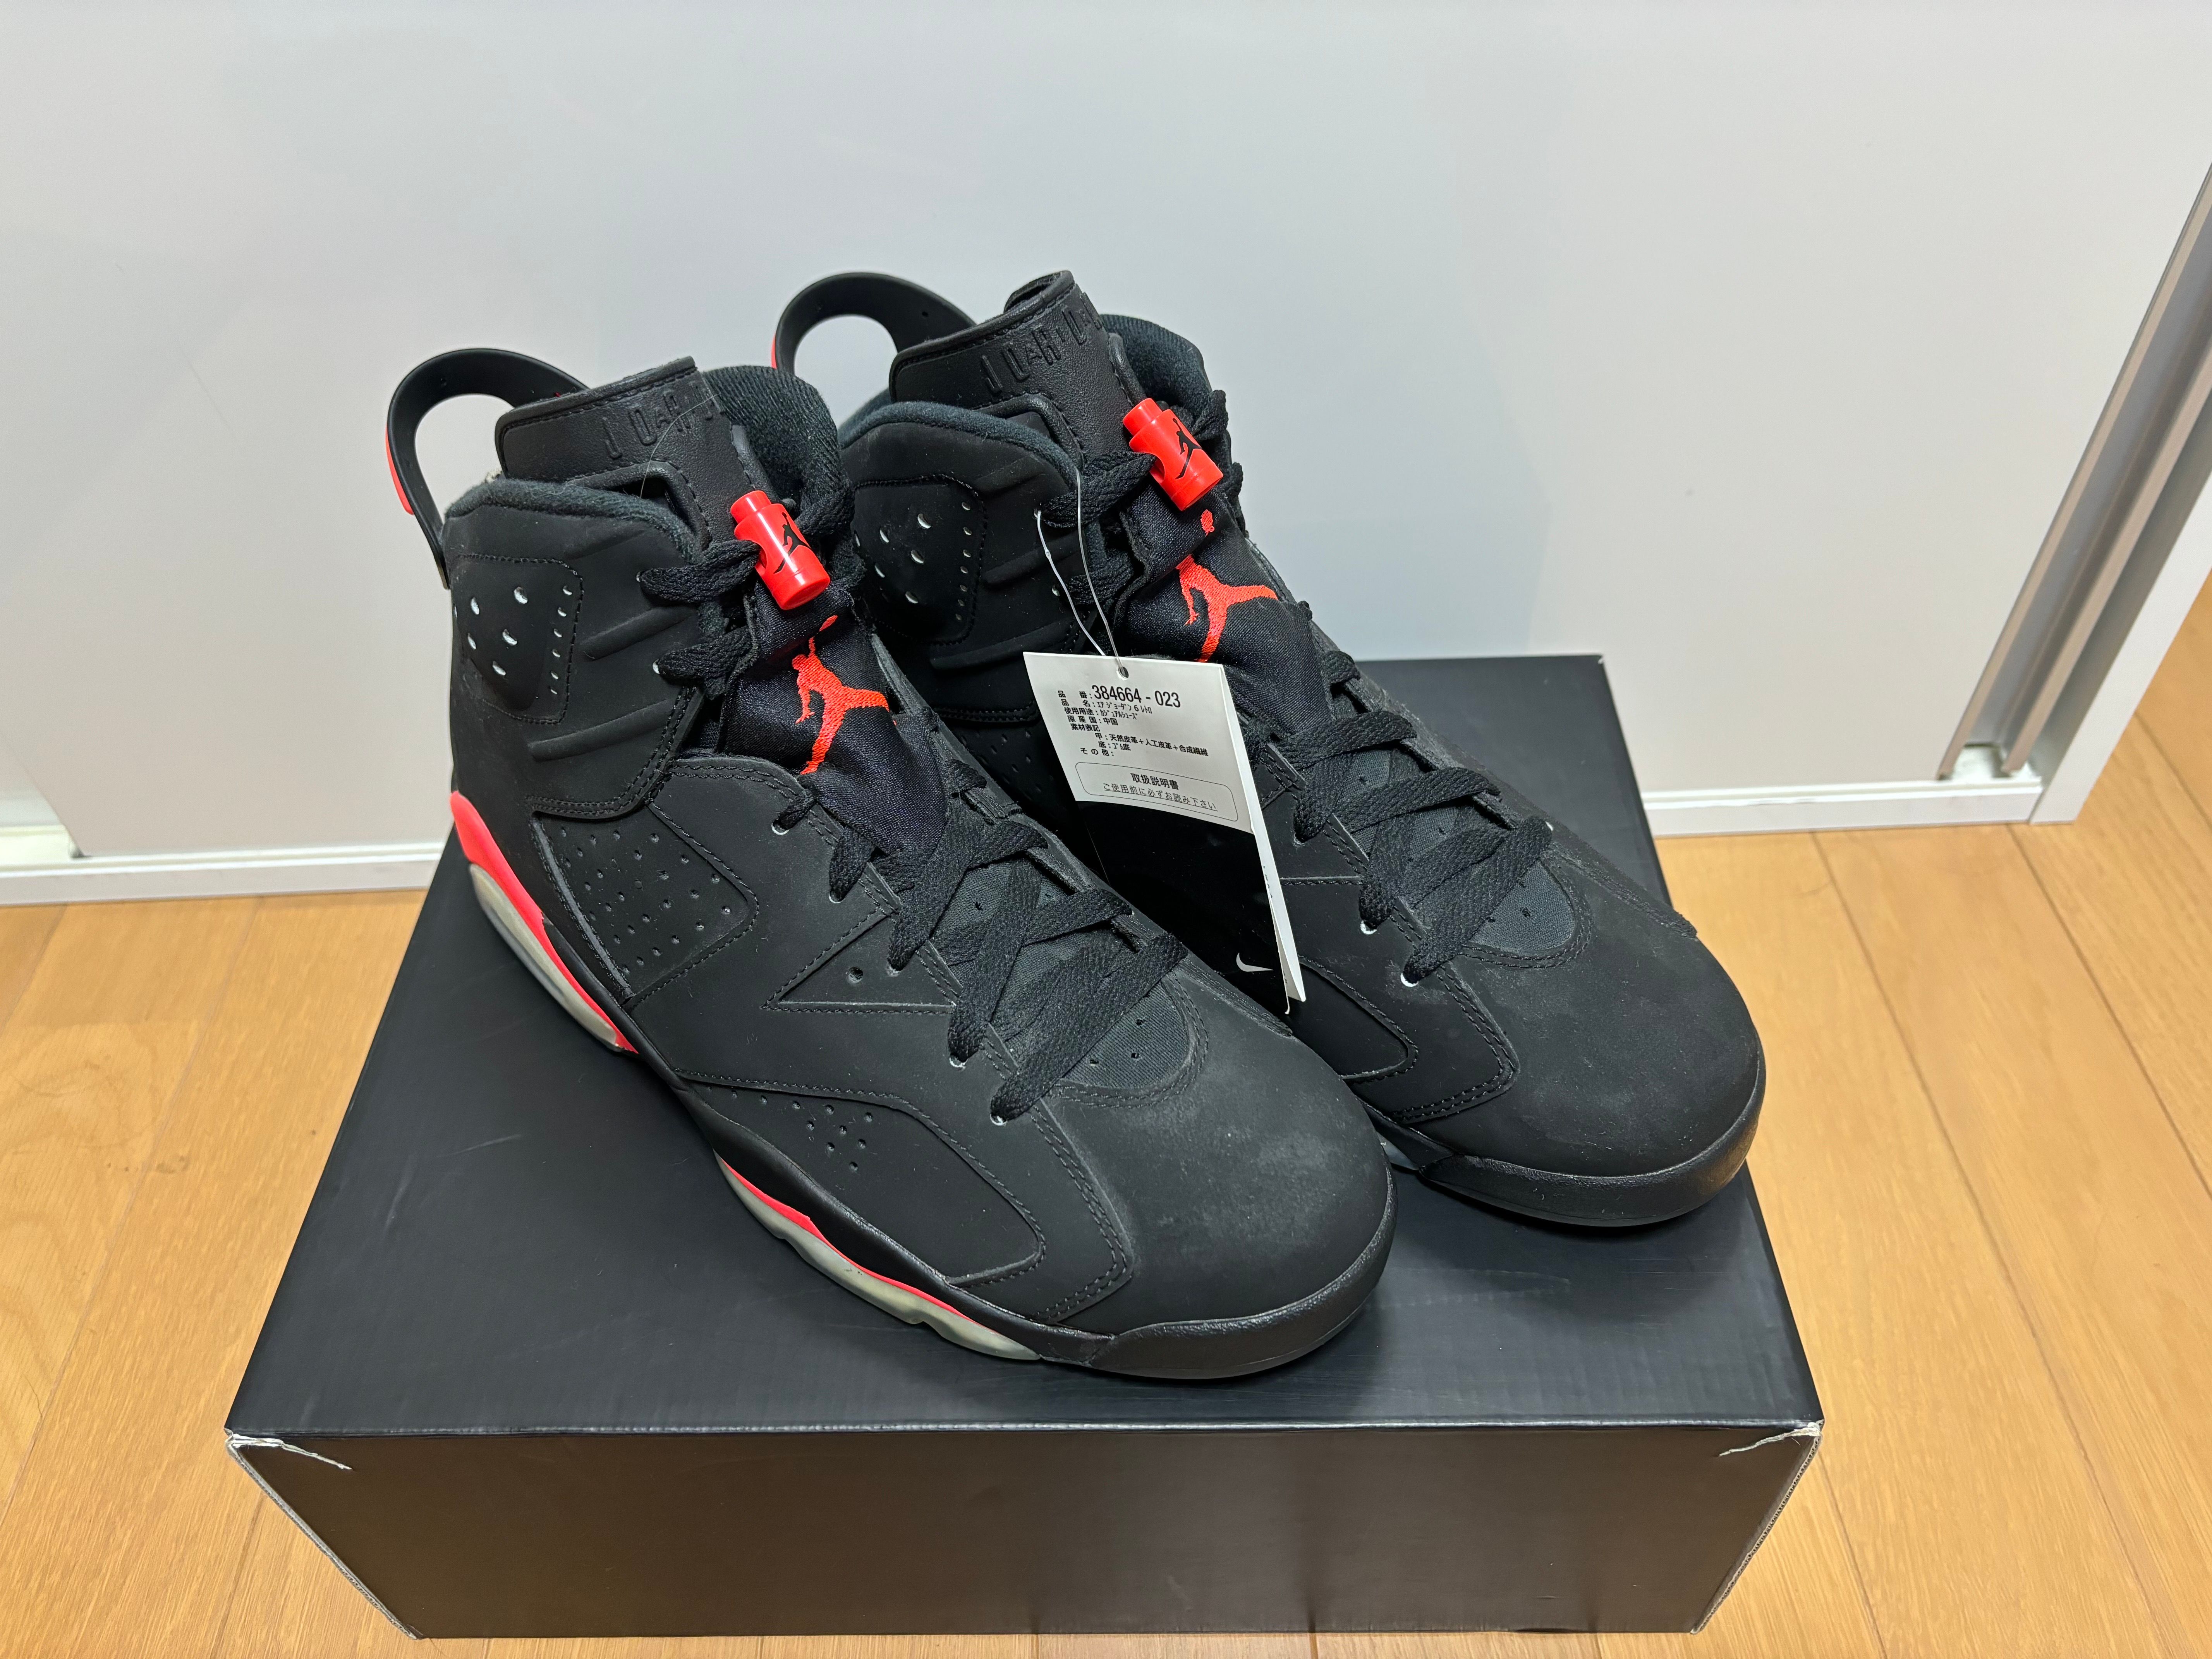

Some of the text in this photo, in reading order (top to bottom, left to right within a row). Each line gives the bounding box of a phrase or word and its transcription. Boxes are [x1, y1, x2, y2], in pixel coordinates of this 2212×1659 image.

[1130, 773, 1179, 790] 取扱説明書
[1103, 783, 1216, 809] ご使用前に必ずお読み下さい
